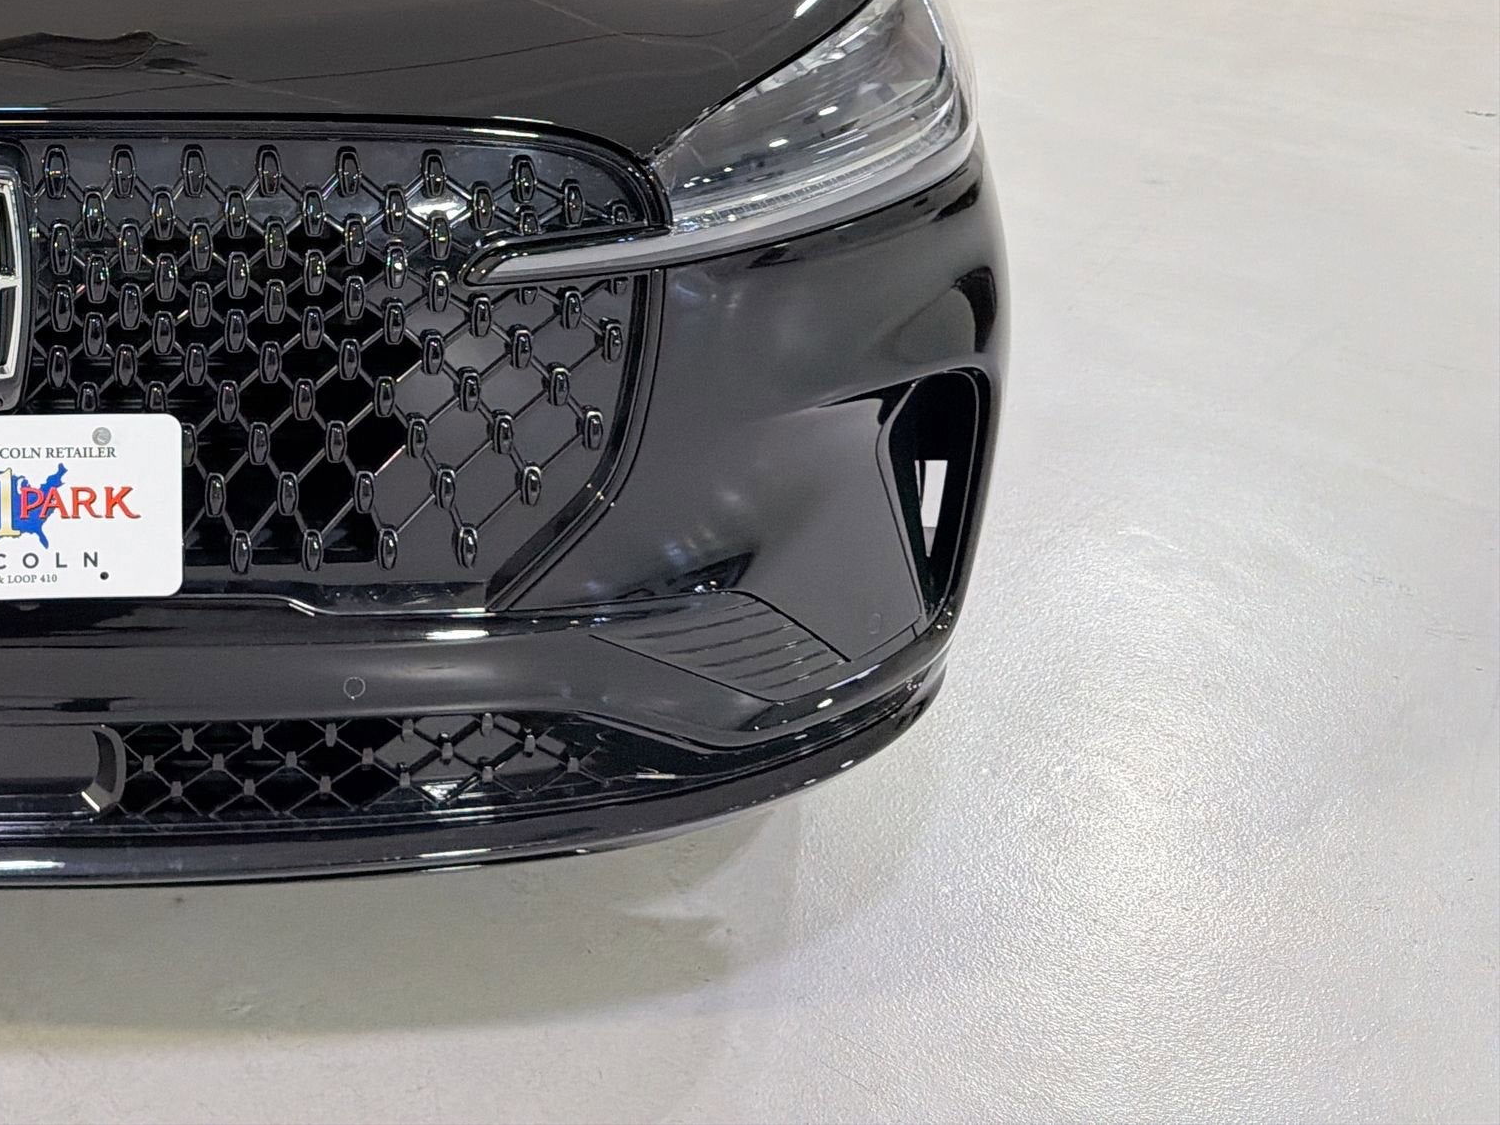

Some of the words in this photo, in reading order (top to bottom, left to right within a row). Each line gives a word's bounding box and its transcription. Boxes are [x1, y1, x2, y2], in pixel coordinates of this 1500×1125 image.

[45, 446, 117, 459] RETAILER
[19, 485, 142, 520] PARK
[7, 574, 39, 585] LOOP
[40, 573, 58, 584] 410
